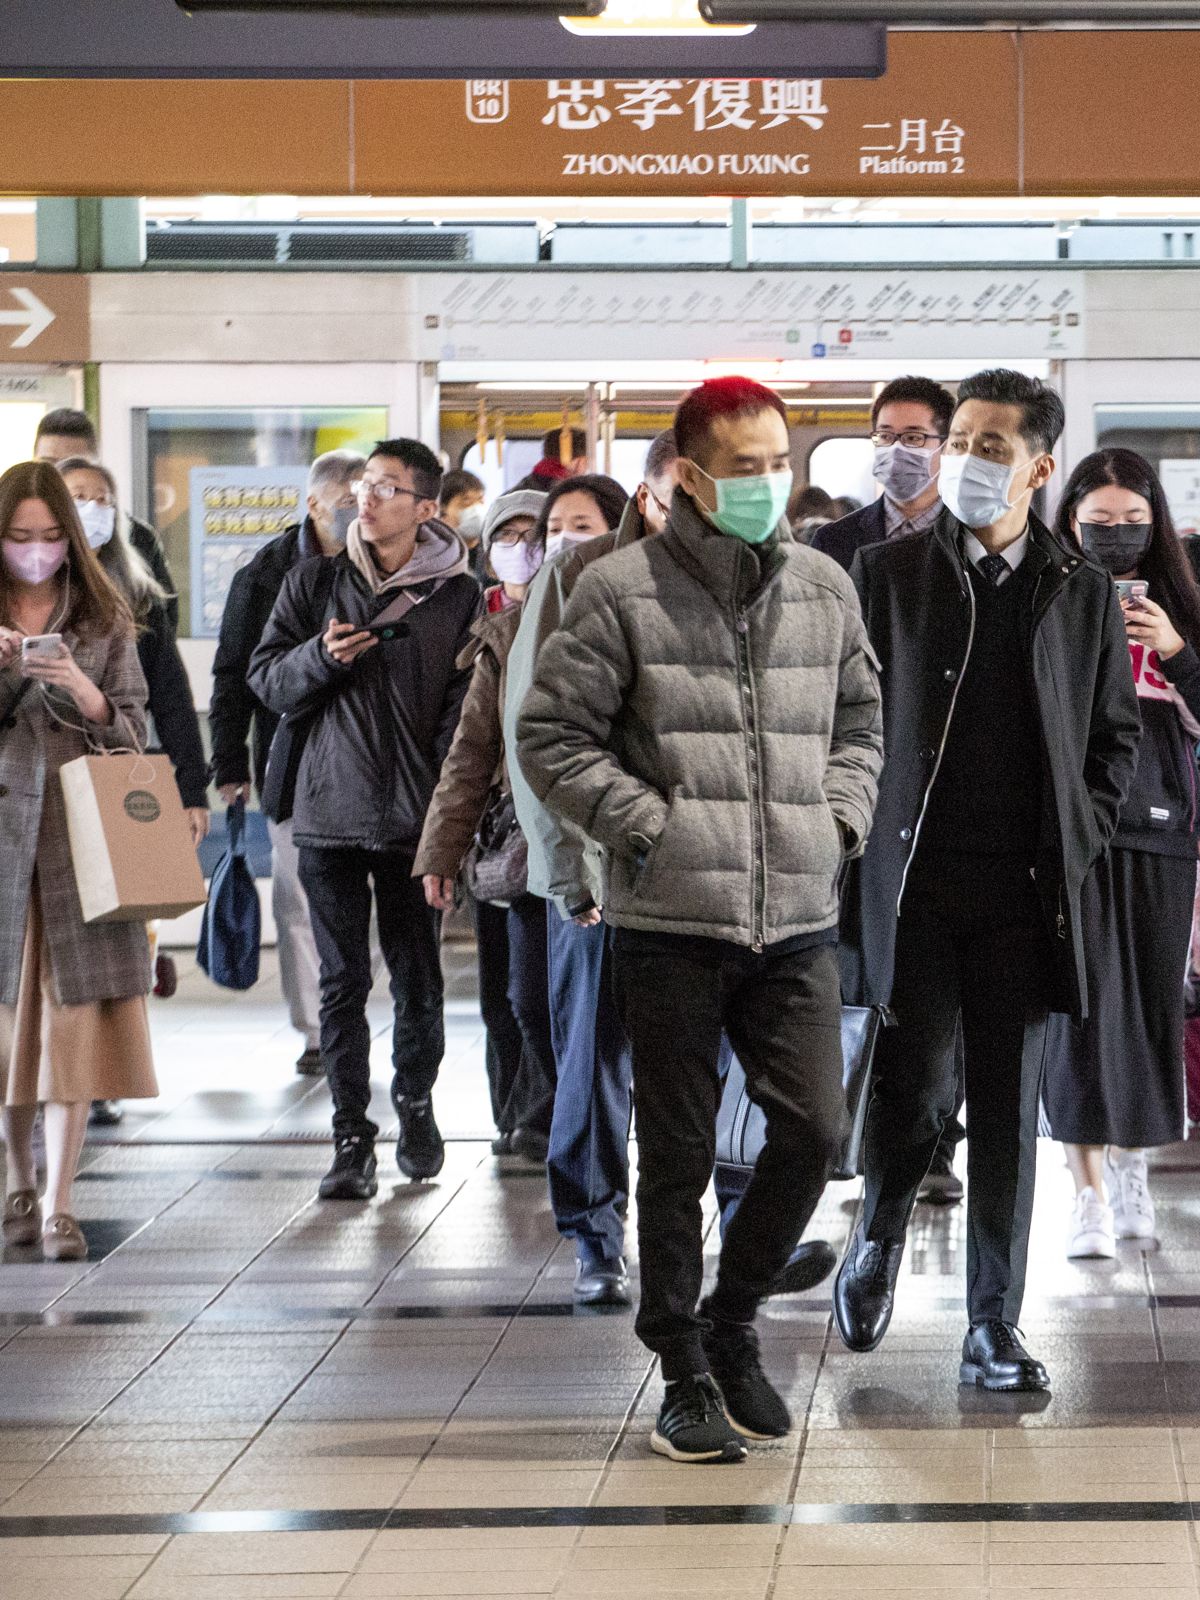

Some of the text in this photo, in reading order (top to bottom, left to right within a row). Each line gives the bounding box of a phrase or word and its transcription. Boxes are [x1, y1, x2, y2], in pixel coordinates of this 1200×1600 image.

[472, 79, 503, 96] BR
[475, 98, 500, 117] 10
[541, 79, 829, 132] 忠孝復興
[859, 118, 965, 154] 二月台
[562, 153, 810, 175] ZHONGXIAO FUXING
[859, 155, 965, 174] Platform 2
